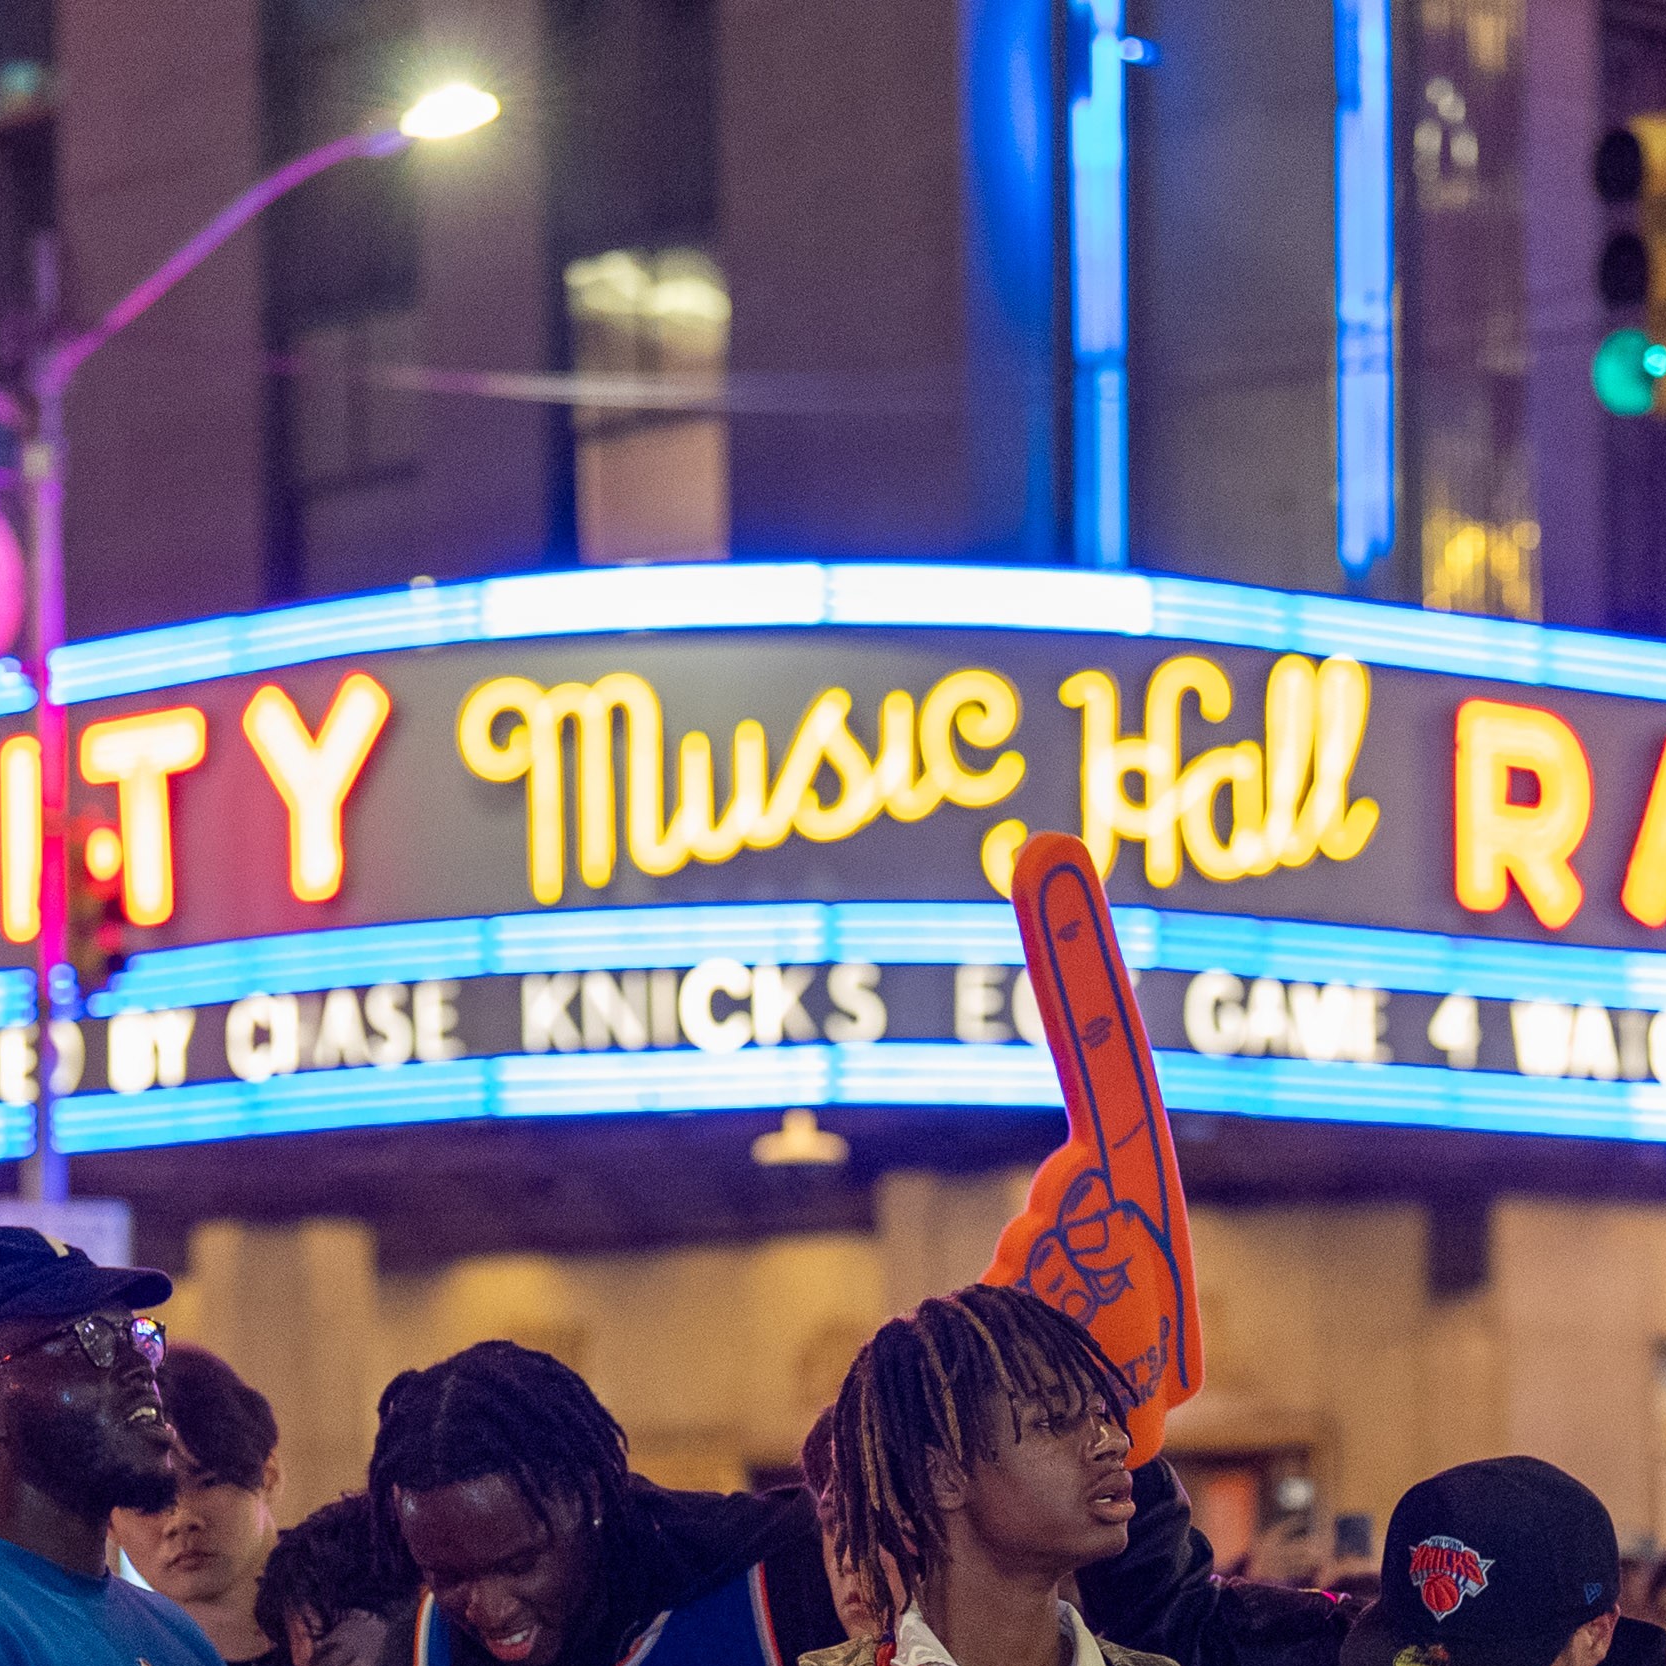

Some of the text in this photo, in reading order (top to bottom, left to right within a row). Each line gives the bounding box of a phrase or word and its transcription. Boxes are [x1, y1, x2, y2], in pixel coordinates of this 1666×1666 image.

[459, 654, 1379, 905] Music Hall
[108, 1007, 194, 1093] BY
[225, 980, 463, 1081] CHASE
[522, 956, 887, 1053] KNICKS
[1184, 969, 1389, 1062] GAME
[1428, 992, 1480, 1069] 4
[1410, 1545, 1485, 1585] KNICKS
